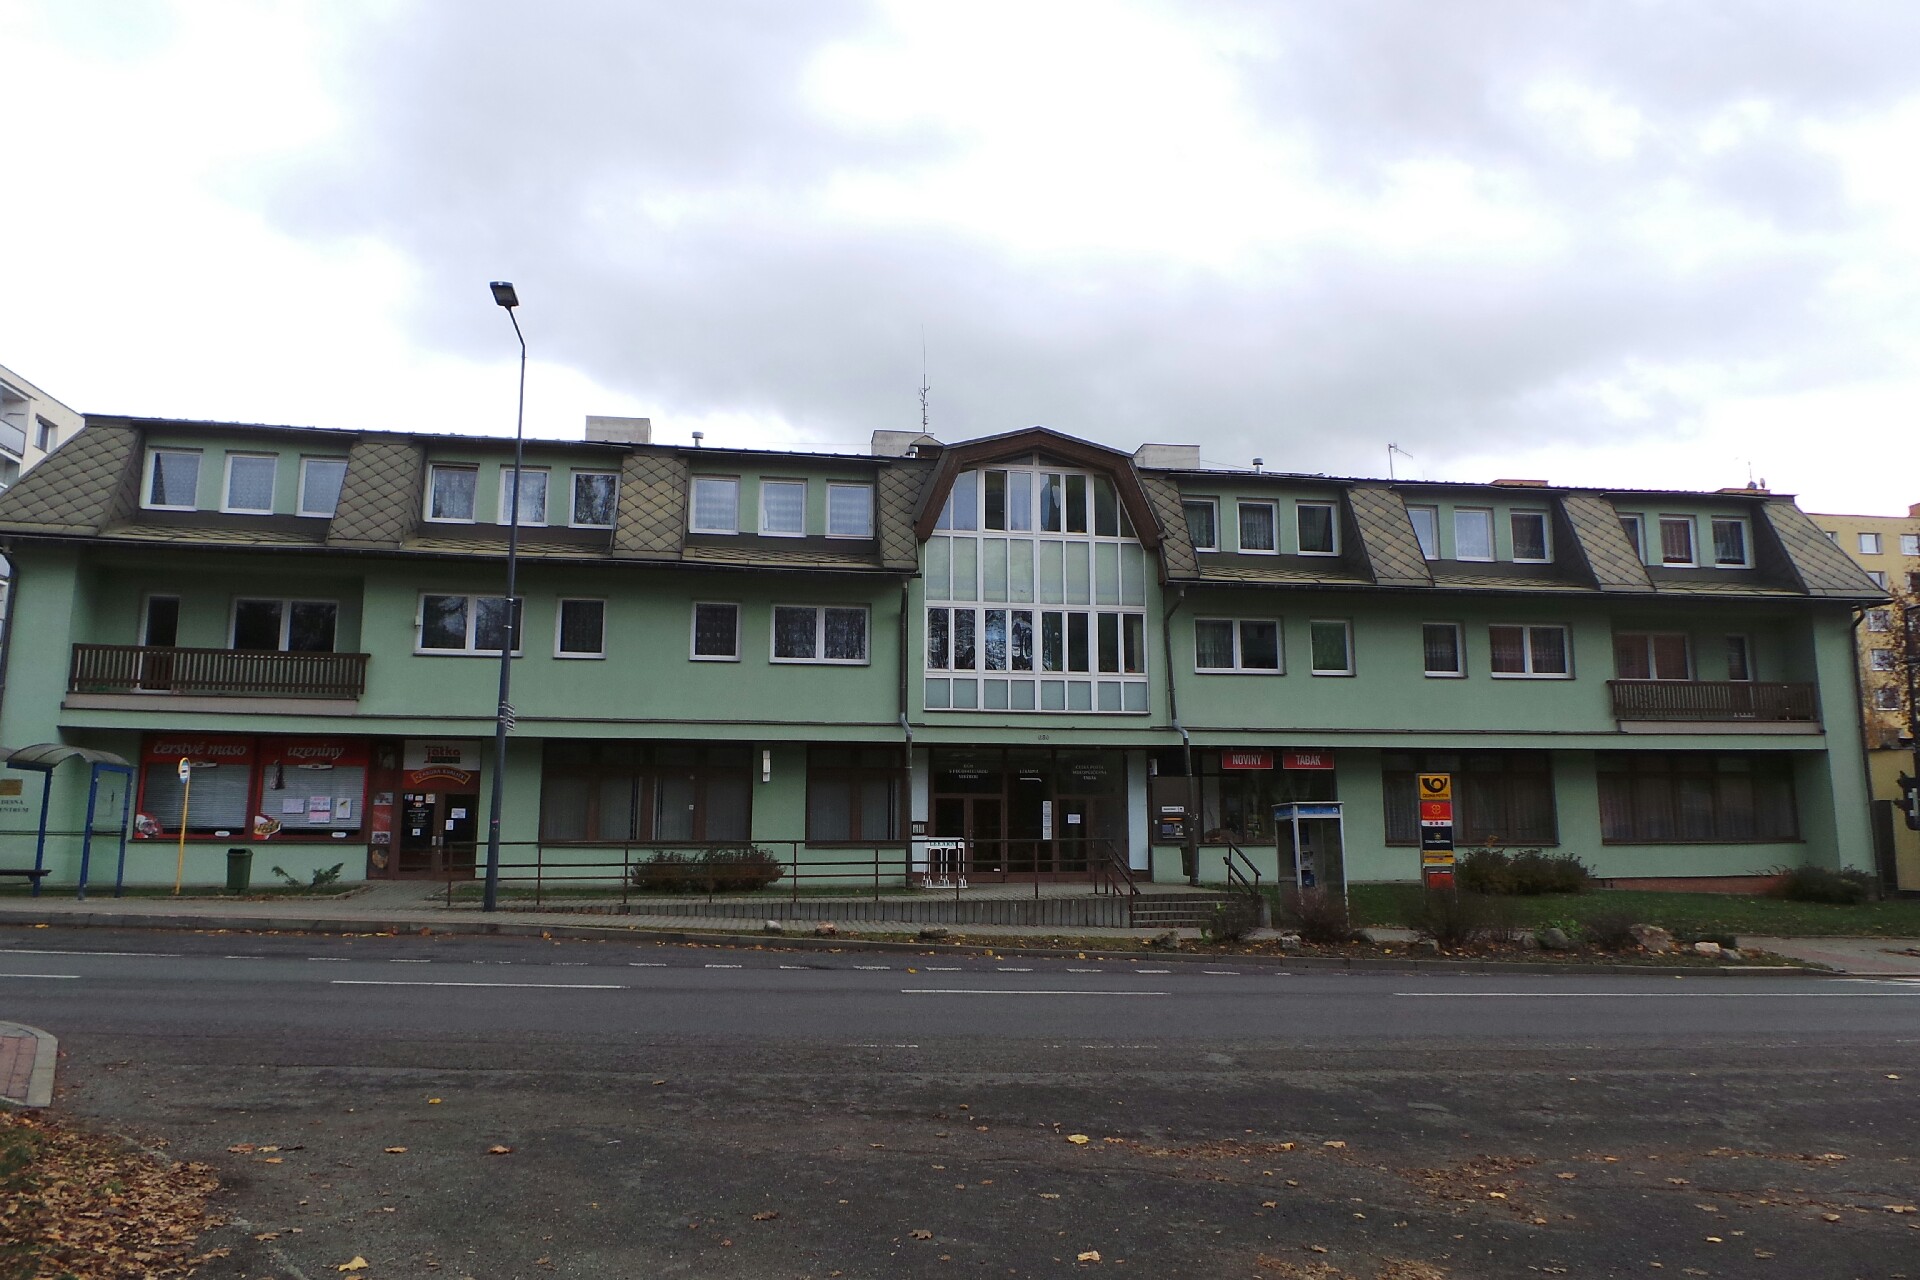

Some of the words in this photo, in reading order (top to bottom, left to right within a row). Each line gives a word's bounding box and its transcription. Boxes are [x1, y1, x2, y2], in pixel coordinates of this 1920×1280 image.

[153, 742, 206, 756] čerstvé
[208, 745, 247, 756] maso
[287, 744, 344, 759] uzeniny
[1232, 754, 1262, 765] NOVINY
